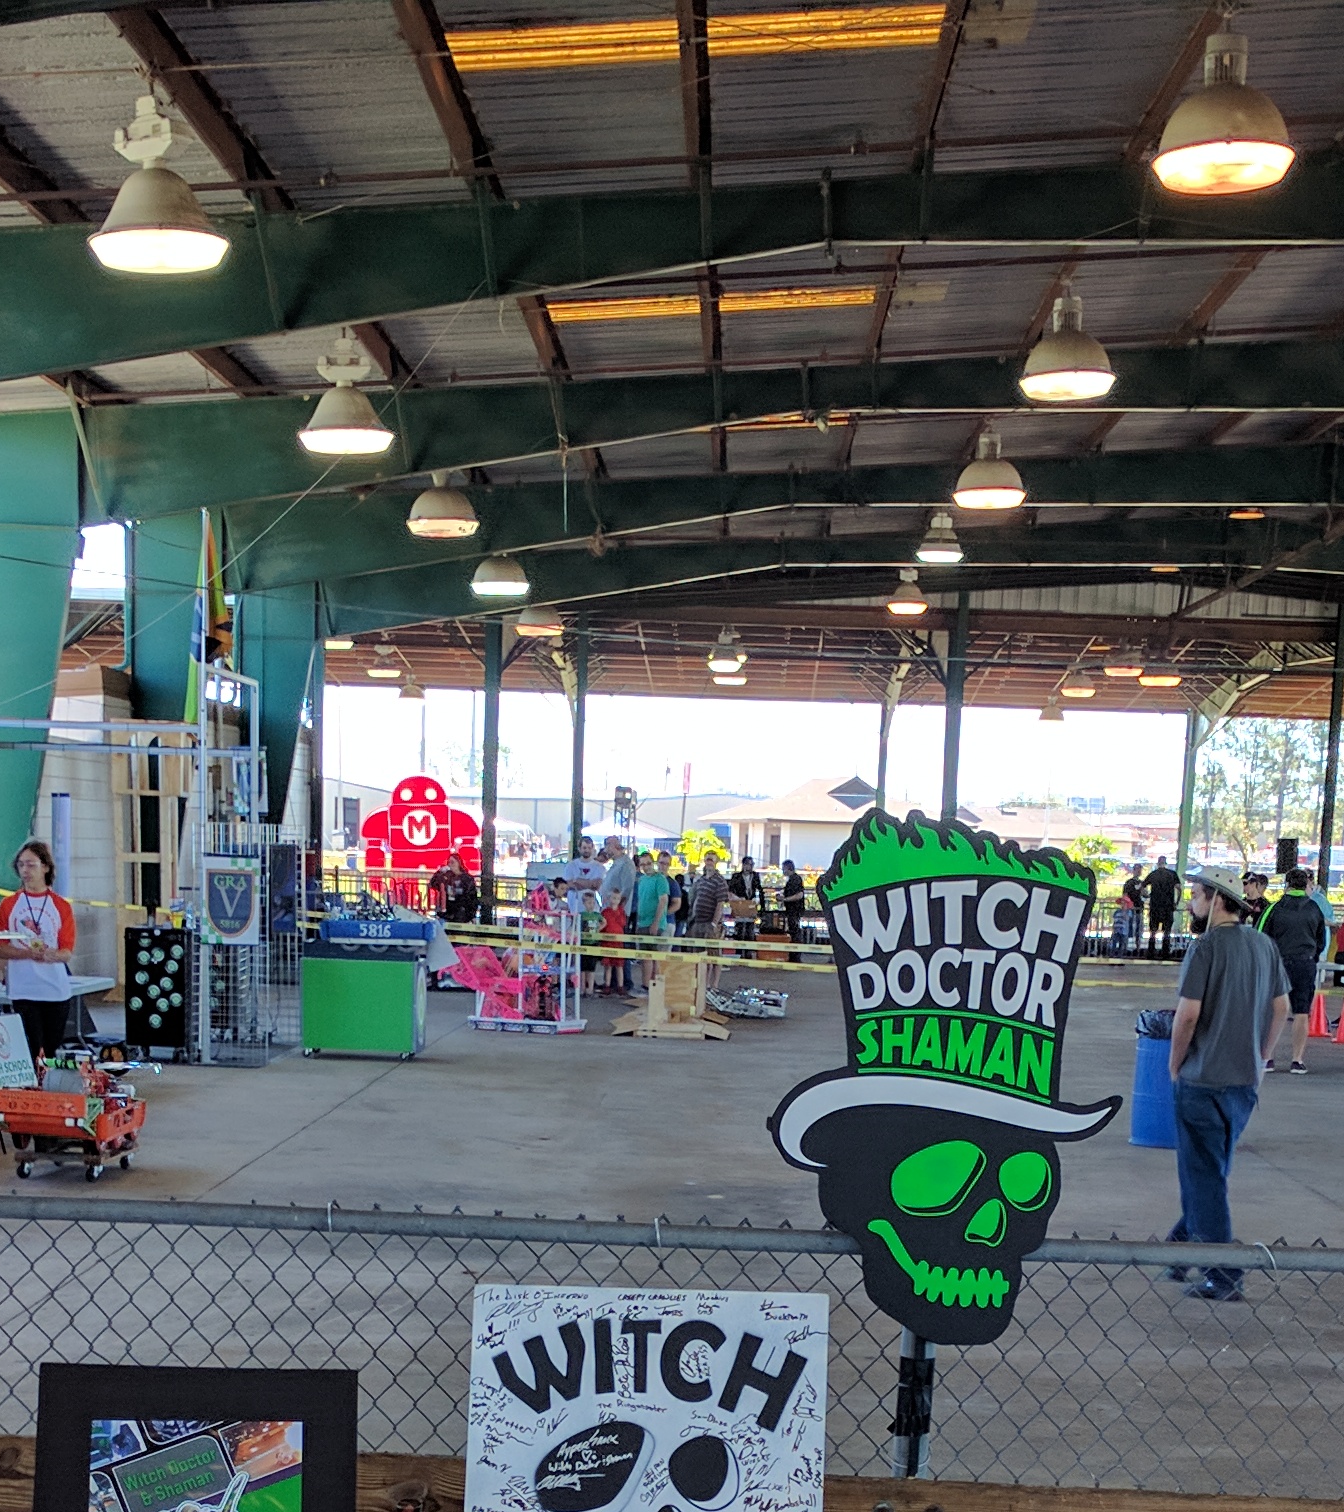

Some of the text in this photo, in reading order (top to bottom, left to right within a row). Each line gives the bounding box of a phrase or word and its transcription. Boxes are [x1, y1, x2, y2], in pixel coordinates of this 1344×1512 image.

[408, 815, 431, 839] M
[359, 923, 392, 938] 5816
[832, 878, 1087, 964] WITCH
[846, 946, 1065, 1029] DOCTOR
[5, 1059, 32, 1073] SCHOOL
[855, 1015, 1055, 1097] SHAMAN
[492, 1318, 808, 1433] WITCH
[123, 1448, 217, 1492] Witch Doctor
[139, 1469, 216, 1507] & Shaman
